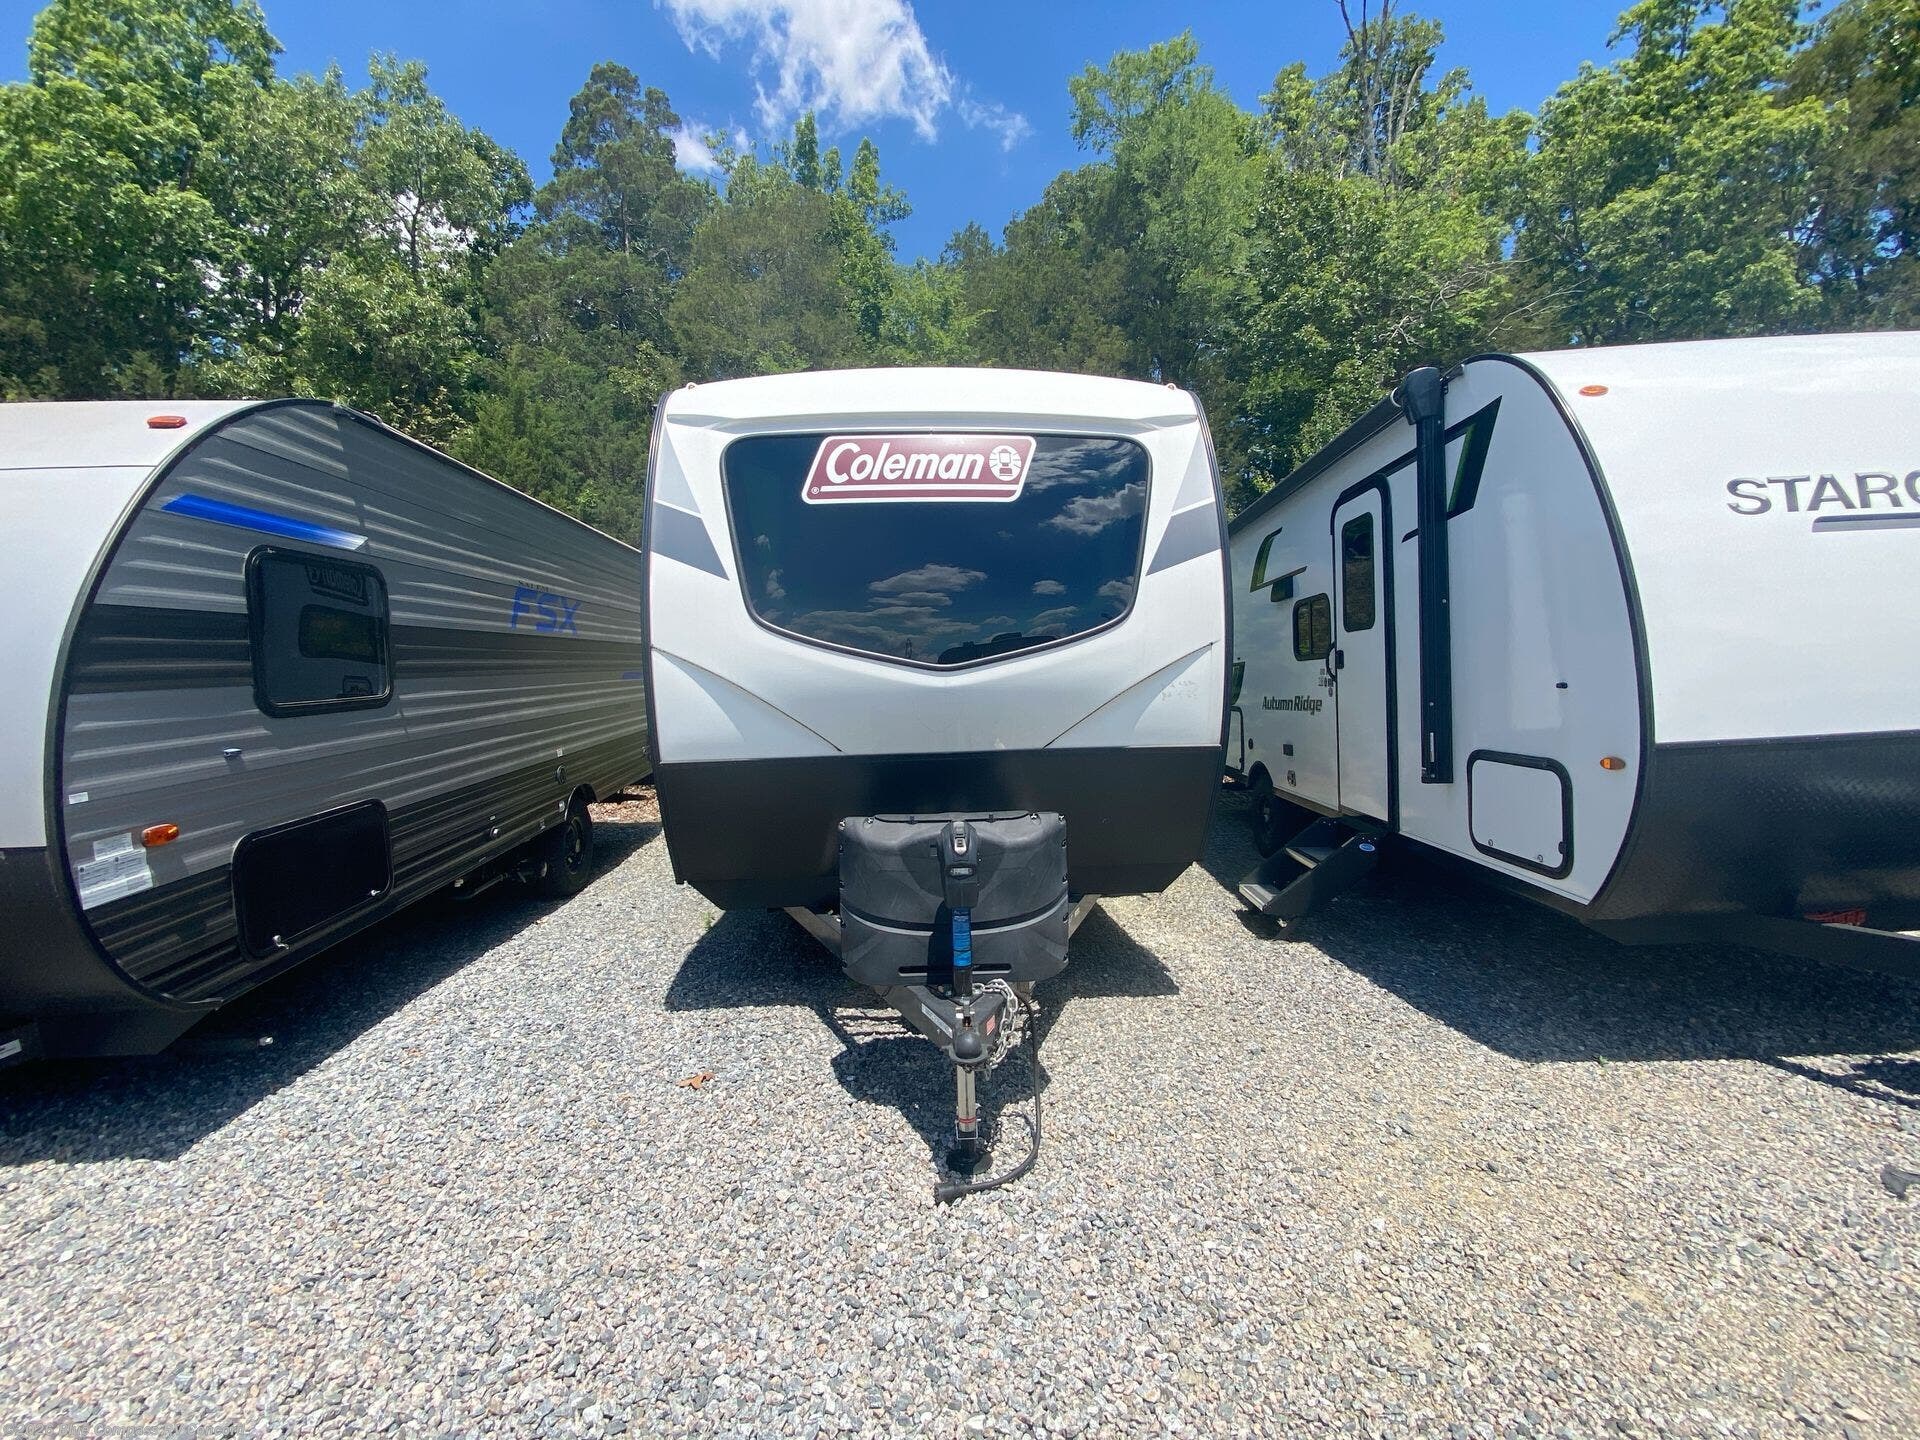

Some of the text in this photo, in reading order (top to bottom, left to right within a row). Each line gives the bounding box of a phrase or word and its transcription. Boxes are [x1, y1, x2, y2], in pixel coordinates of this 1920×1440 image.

[826, 442, 985, 484] Coleman
[511, 586, 582, 636] FSX
[1262, 695, 1323, 715] Autumn Ridge
